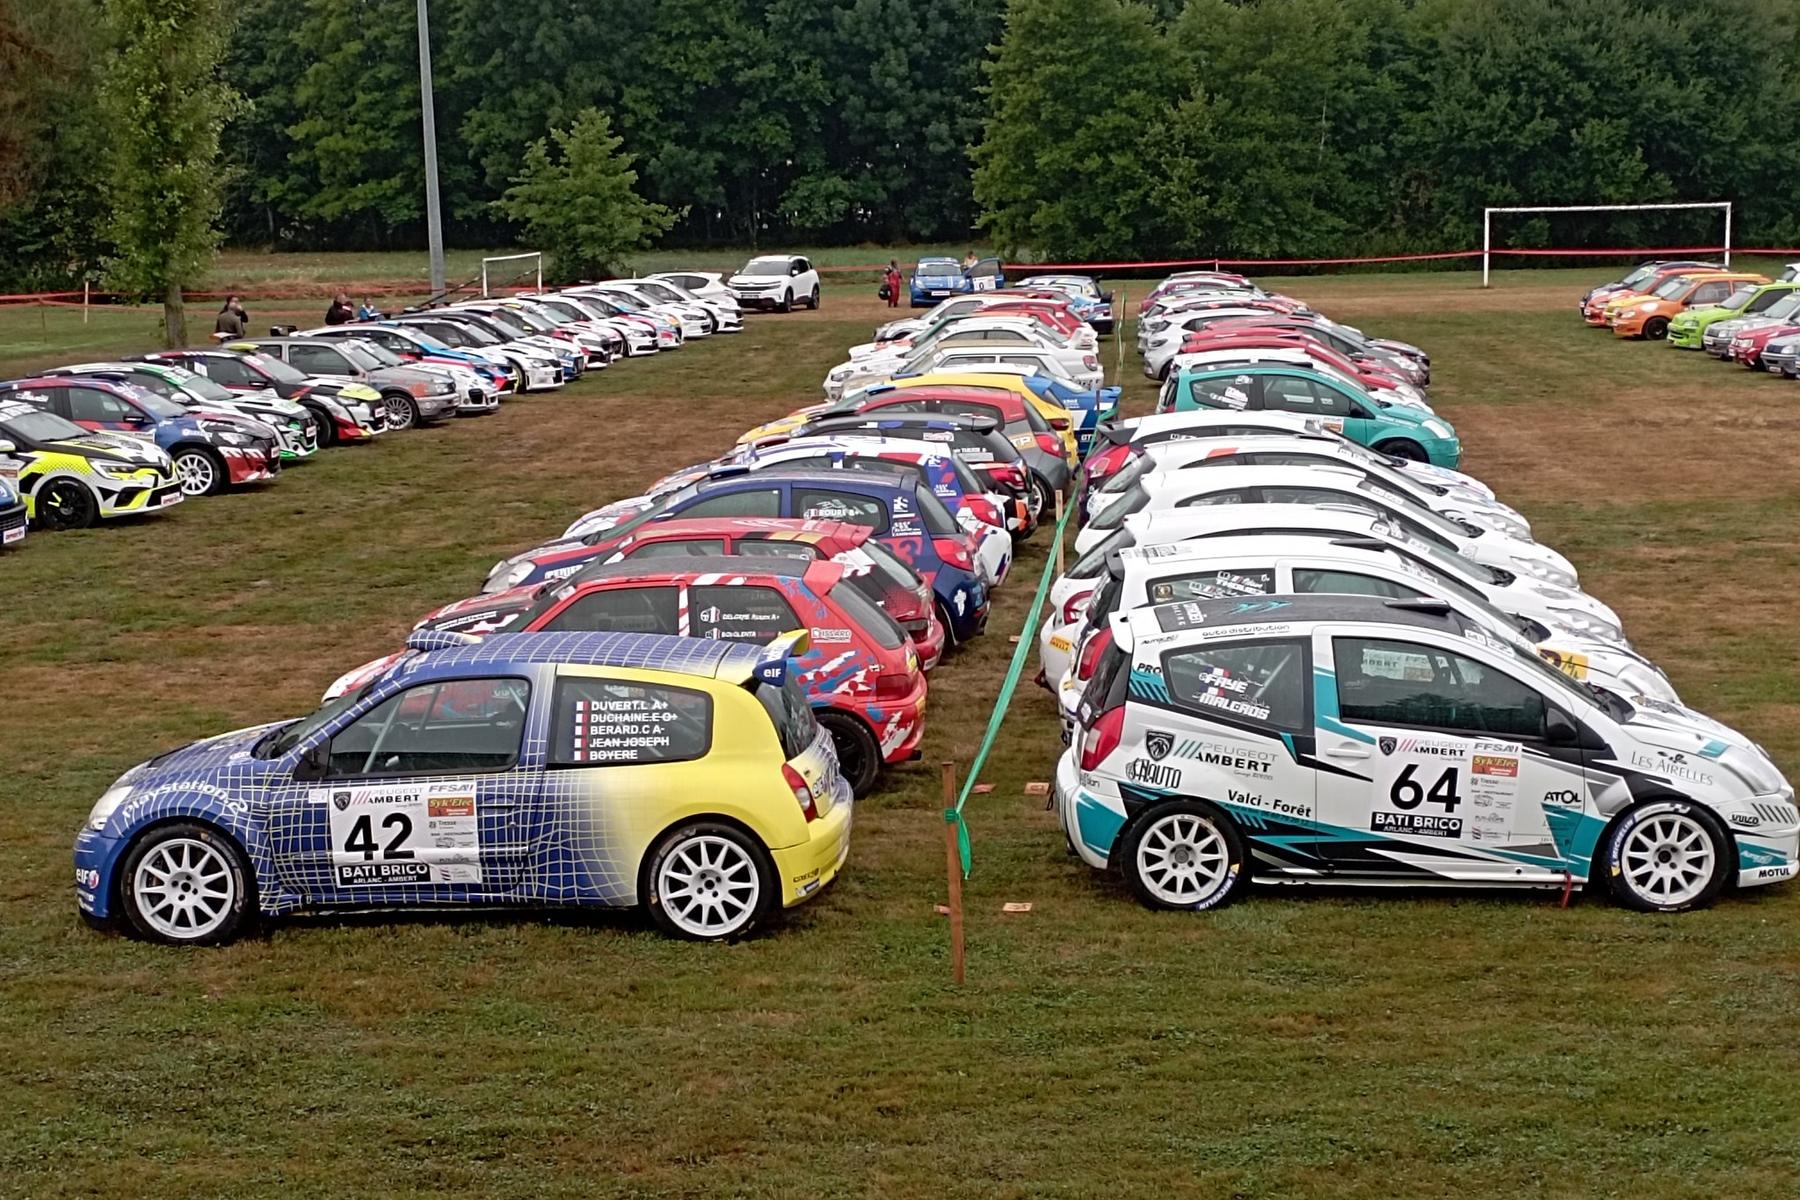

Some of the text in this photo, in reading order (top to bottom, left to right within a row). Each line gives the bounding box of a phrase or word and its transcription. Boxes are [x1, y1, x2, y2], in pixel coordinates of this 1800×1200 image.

[1202, 625, 1290, 637] auto distribution
[1137, 663, 1161, 674] PRO
[1206, 674, 1248, 694] FAYE
[591, 700, 668, 711] DUVERT.L A+
[590, 713, 659, 723] DUCHAINE.E
[590, 725, 650, 735] BERARD.C
[589, 736, 670, 748] JEAN JOSEPH
[589, 750, 638, 760] BOYERE
[1413, 747, 1465, 757] AMBERT
[1195, 752, 1272, 773] AMBERT
[1631, 751, 1714, 786] LES AIRELLES
[1390, 763, 1462, 813] 64
[368, 794, 420, 804] AMBERT
[1228, 789, 1261, 807] Valci
[1273, 798, 1312, 818] Forêt
[1544, 790, 1582, 805] ATOL
[1375, 813, 1409, 827] BATI
[1413, 816, 1461, 831] BRICO
[344, 812, 415, 860] 42
[1418, 828, 1448, 837] AMBERT
[343, 864, 428, 878] BATI BRICO
[1759, 868, 1790, 878] MOTUL
